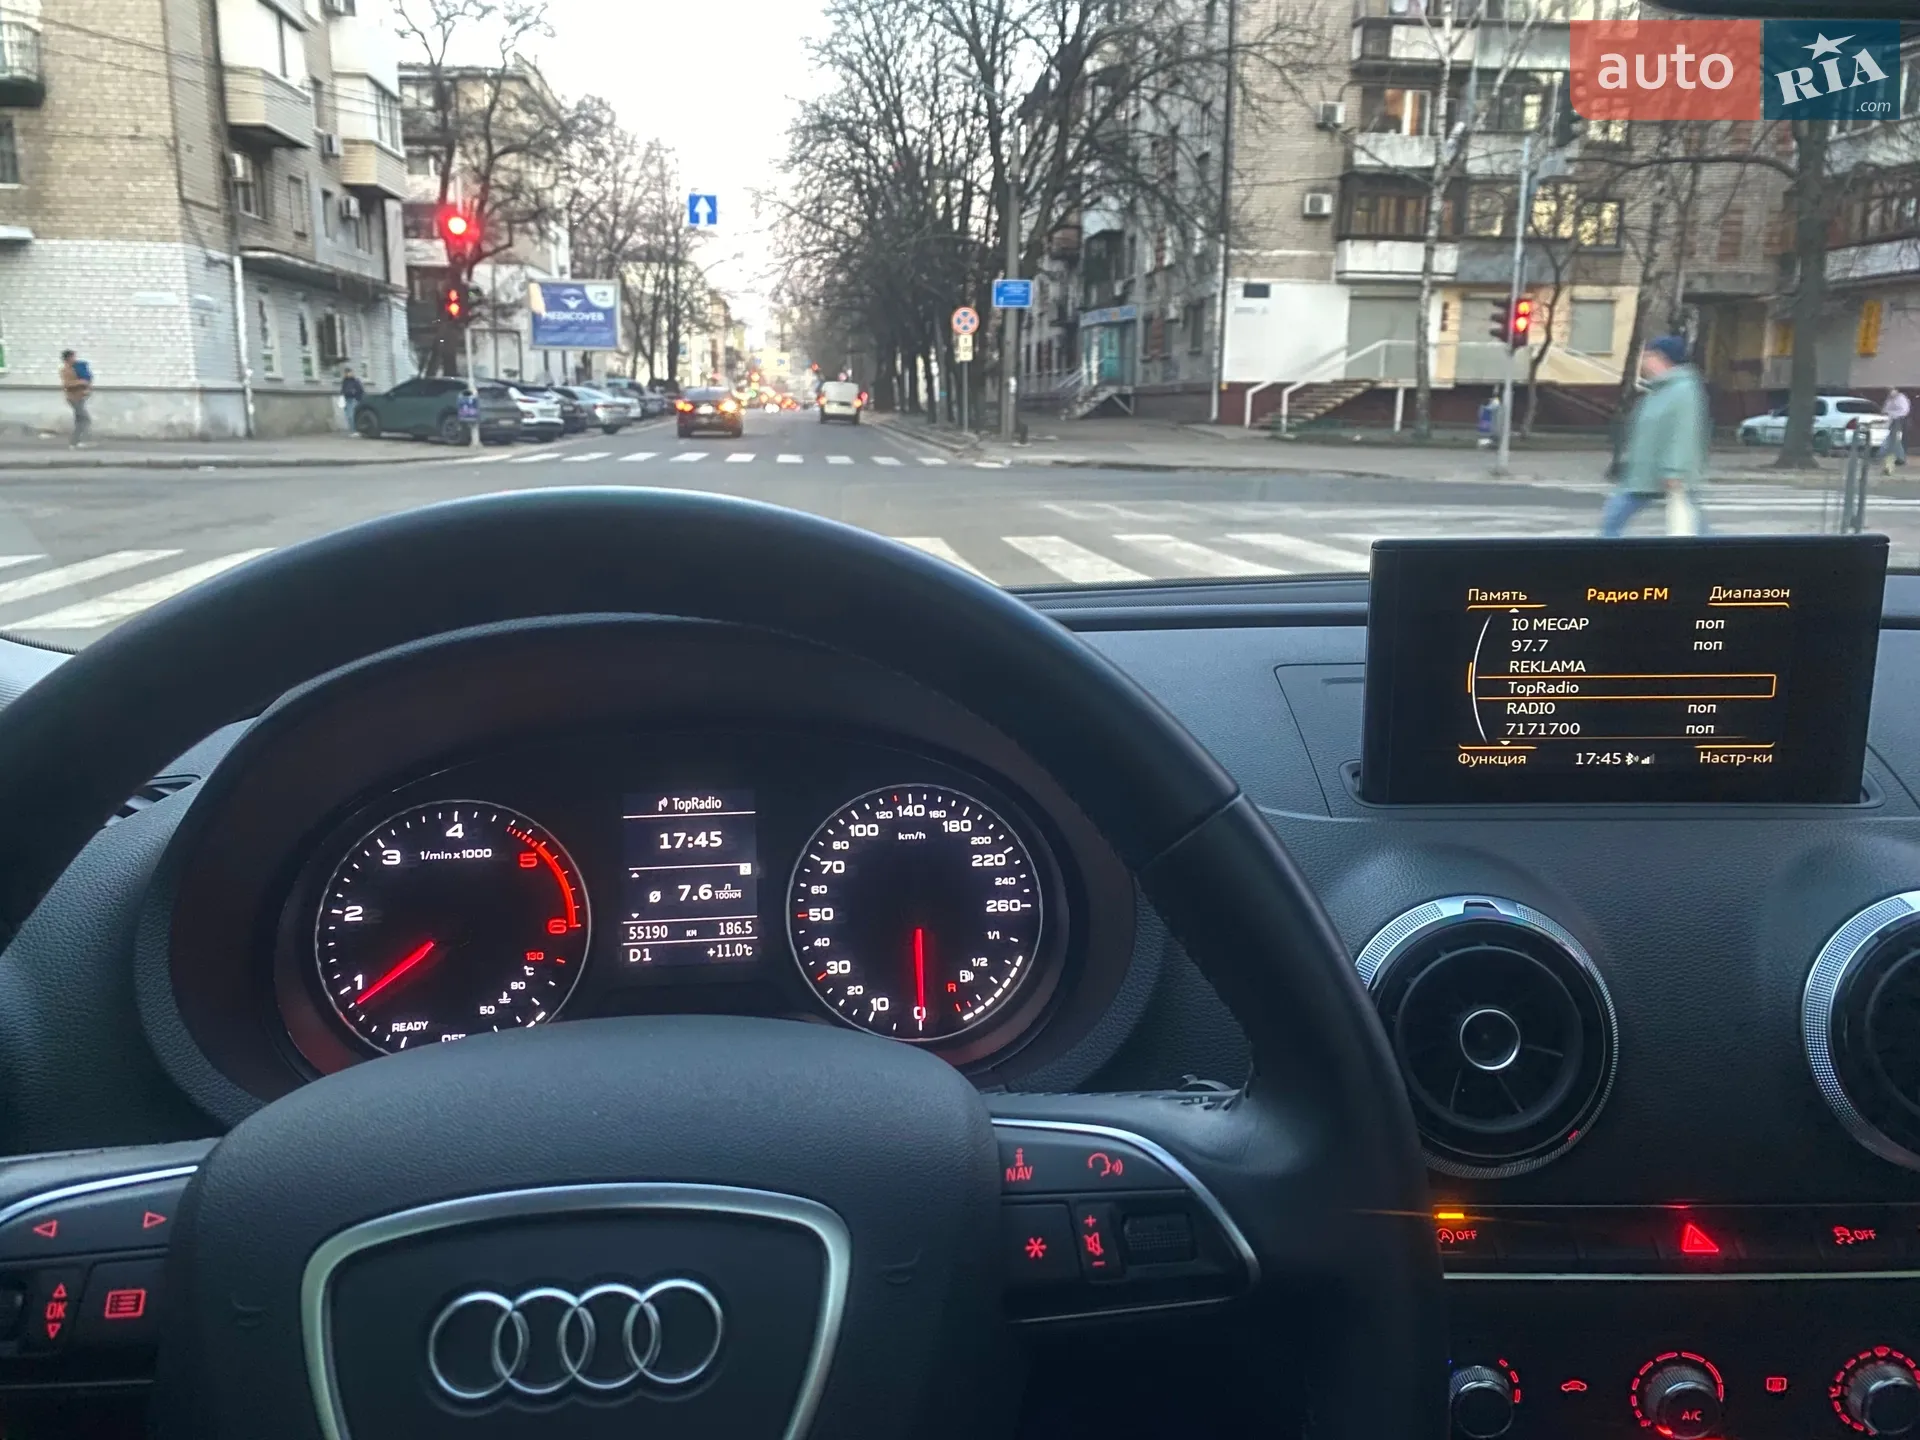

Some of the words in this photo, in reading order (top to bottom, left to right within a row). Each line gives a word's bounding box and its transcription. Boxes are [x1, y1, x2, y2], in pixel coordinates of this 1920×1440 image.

[1468, 588, 1528, 601] Память
[1587, 588, 1639, 603] Радио
[1643, 587, 1668, 600] FM
[1709, 585, 1790, 601] Диапазон
[1533, 617, 1590, 631] MEGAP
[1695, 619, 1725, 630] поп
[1511, 639, 1549, 652] 97.7
[1693, 640, 1723, 651] поп
[1509, 660, 1587, 673] REKLAMA
[1508, 681, 1580, 697] TopRadio
[1506, 702, 1556, 715] RADIO
[1687, 704, 1717, 714] поп
[1505, 722, 1581, 736] 7171700
[1685, 724, 1715, 734] поп
[1457, 752, 1527, 768] Функция
[1575, 752, 1622, 765] 17:45
[1699, 751, 1773, 767] Настр-ки
[672, 796, 722, 813] TopRadio
[896, 804, 926, 818] 140
[875, 810, 894, 820] 120
[928, 809, 947, 819] 160
[445, 823, 465, 839] 4
[848, 823, 880, 838] 100
[942, 819, 973, 833] 180
[659, 830, 723, 850] 17:45
[897, 831, 927, 841] km/h
[970, 835, 993, 846] 200
[832, 840, 850, 851] 80
[381, 849, 402, 866] 3
[518, 852, 538, 869] 5
[971, 853, 1007, 868] 220
[820, 860, 846, 875] 70
[994, 876, 1016, 886] 240
[677, 883, 713, 902] 7.6
[810, 884, 829, 895] 60
[985, 898, 1021, 913] 260
[343, 905, 364, 922] 2
[808, 907, 834, 922] 50
[546, 918, 568, 935] 6
[628, 925, 669, 940] 55190
[718, 920, 753, 936] 186.5
[813, 937, 831, 948] 40
[986, 930, 1001, 941] 1/1
[525, 951, 545, 962] 130
[629, 948, 652, 963] D1
[971, 956, 989, 968] 1/2
[826, 959, 852, 975] 30
[353, 973, 364, 991] 1
[947, 982, 957, 993] R
[846, 984, 865, 996] 20
[870, 996, 890, 1011] 10
[912, 1005, 927, 1021] 0
[391, 1020, 429, 1033] READY
[1005, 1165, 1034, 1182] NAV
[1455, 1230, 1478, 1241] OFF
[1853, 1229, 1877, 1240] OFF
[45, 1301, 68, 1320] OK
[1681, 1409, 1703, 1421] A/C
